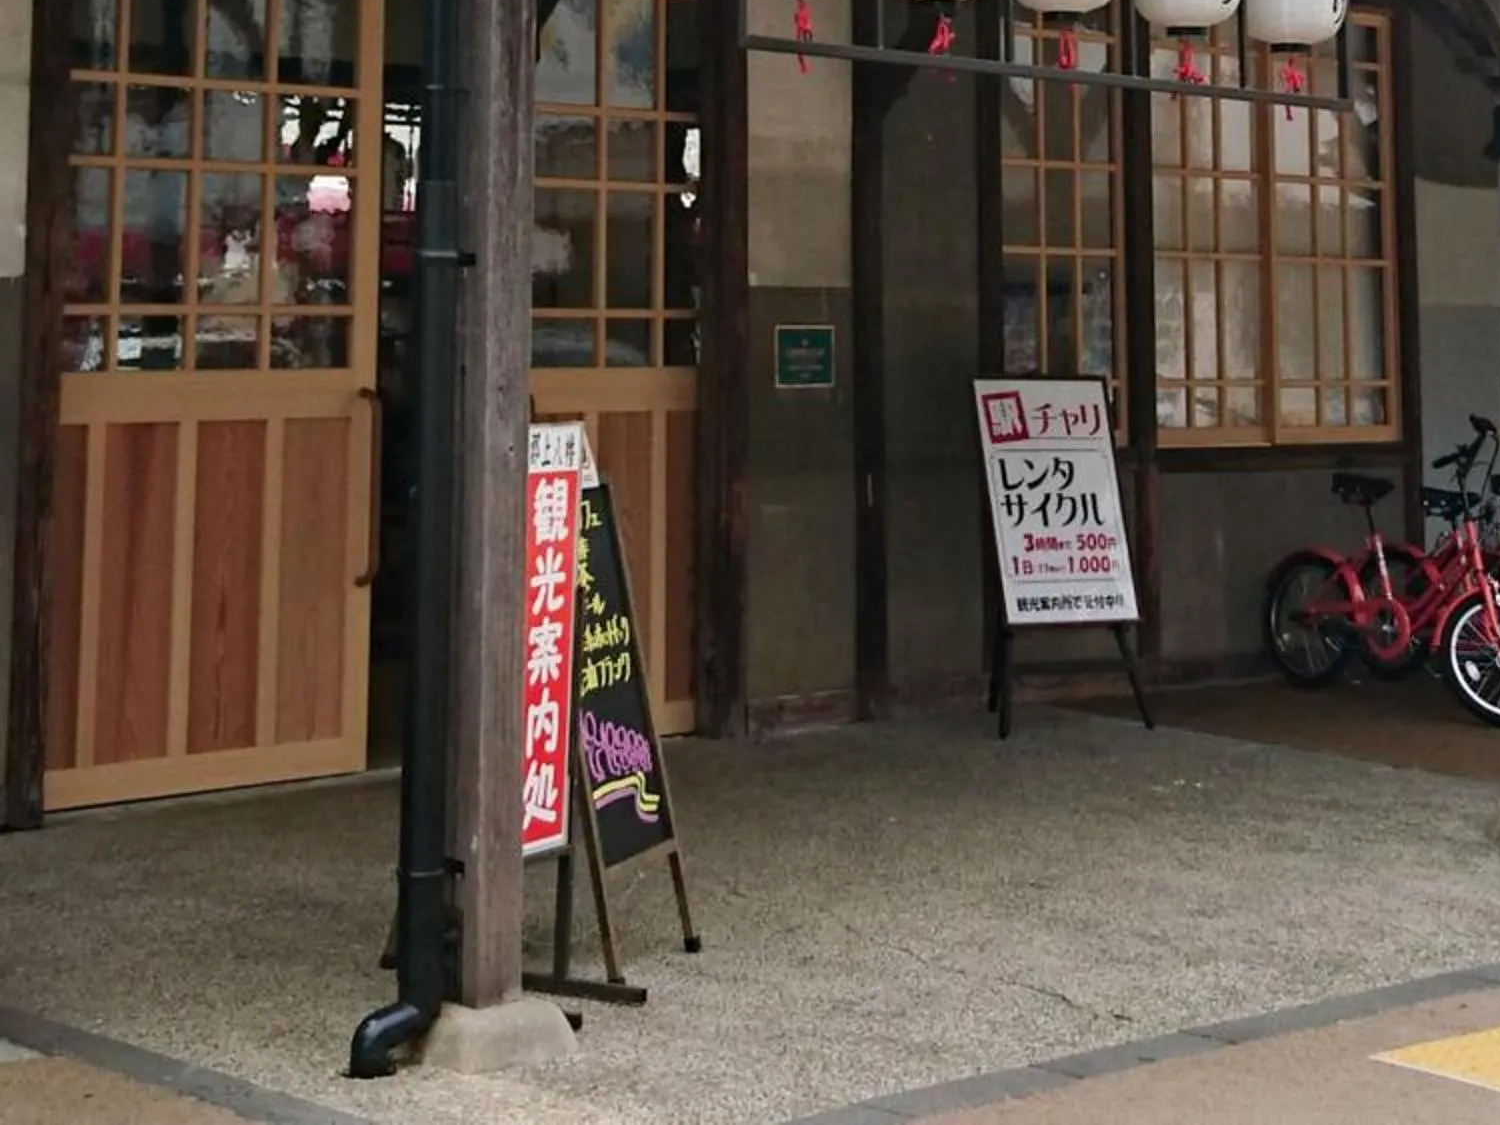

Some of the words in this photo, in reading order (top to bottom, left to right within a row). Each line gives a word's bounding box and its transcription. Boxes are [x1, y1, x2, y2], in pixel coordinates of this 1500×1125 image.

[1031, 403, 1101, 437] チャリ
[1000, 457, 1075, 492] レンタ
[1000, 492, 1104, 528] サイクル
[1076, 532, 1117, 551] 500円
[522, 477, 569, 832] 観光案内処
